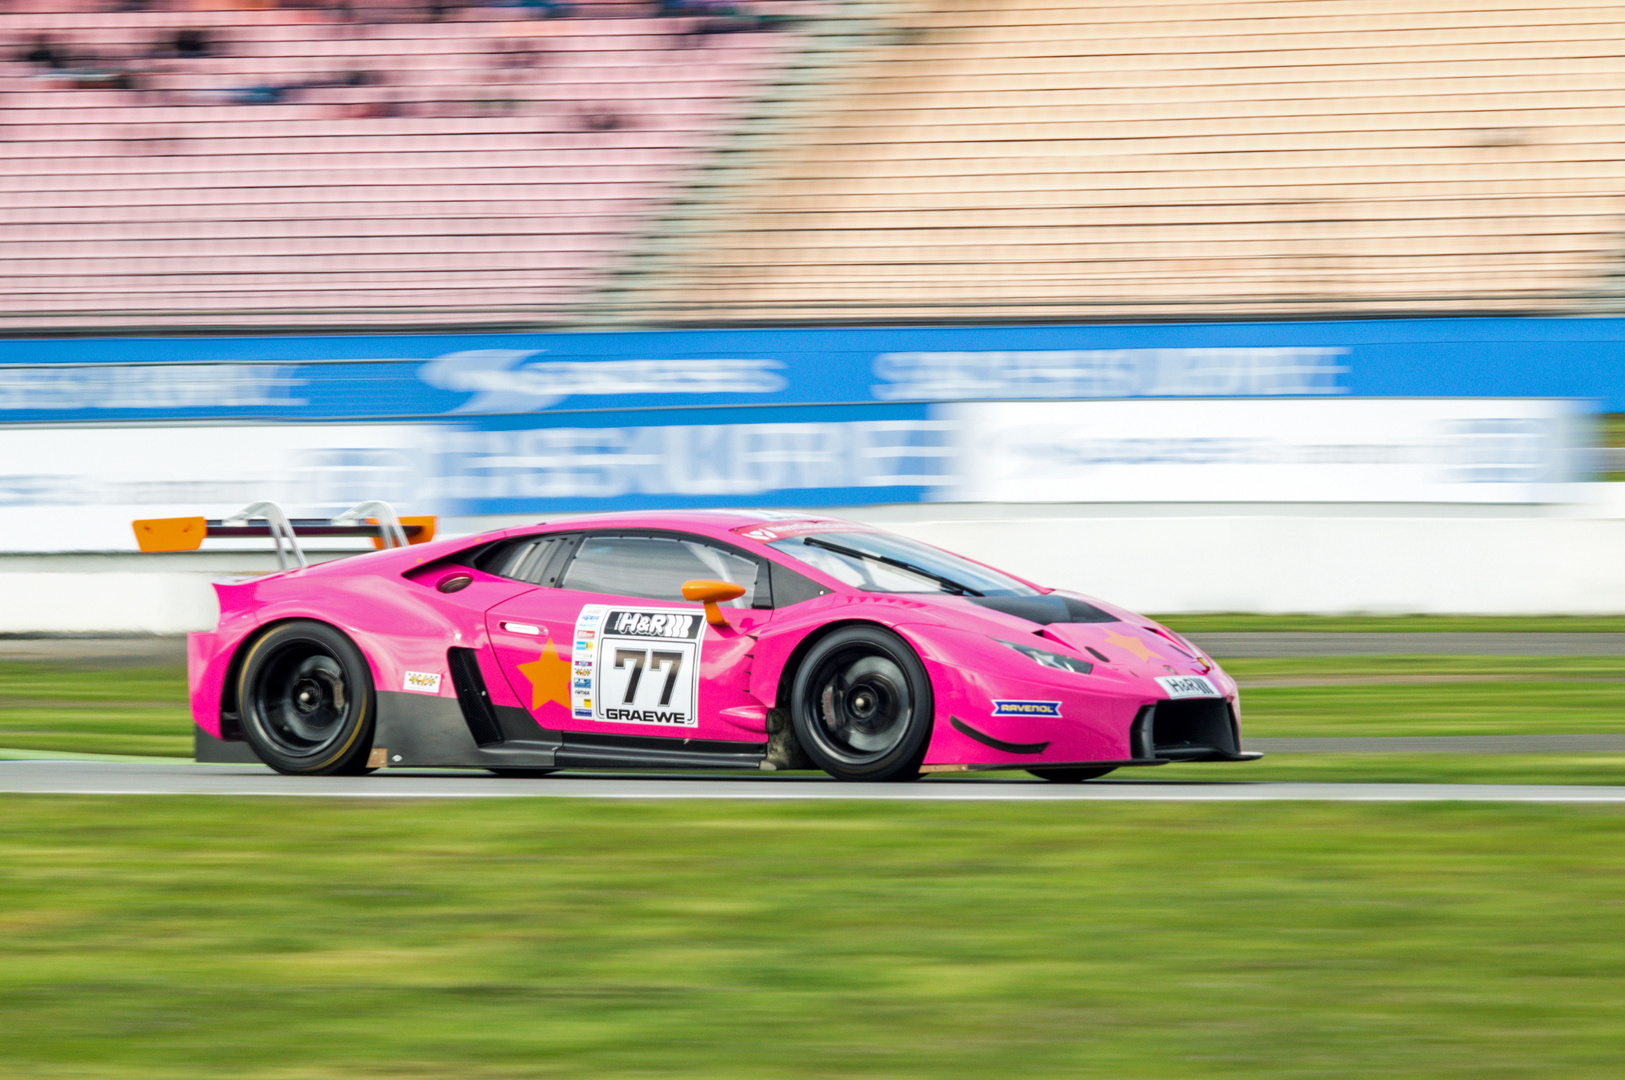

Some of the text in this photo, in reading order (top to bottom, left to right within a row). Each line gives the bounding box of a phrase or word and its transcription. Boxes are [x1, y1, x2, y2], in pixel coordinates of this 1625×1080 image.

[619, 612, 667, 636] H&R
[613, 647, 684, 707] 77
[1165, 678, 1201, 693] H&R
[606, 708, 685, 724] GRAEWE
[1001, 704, 1054, 713] RAVENOL
